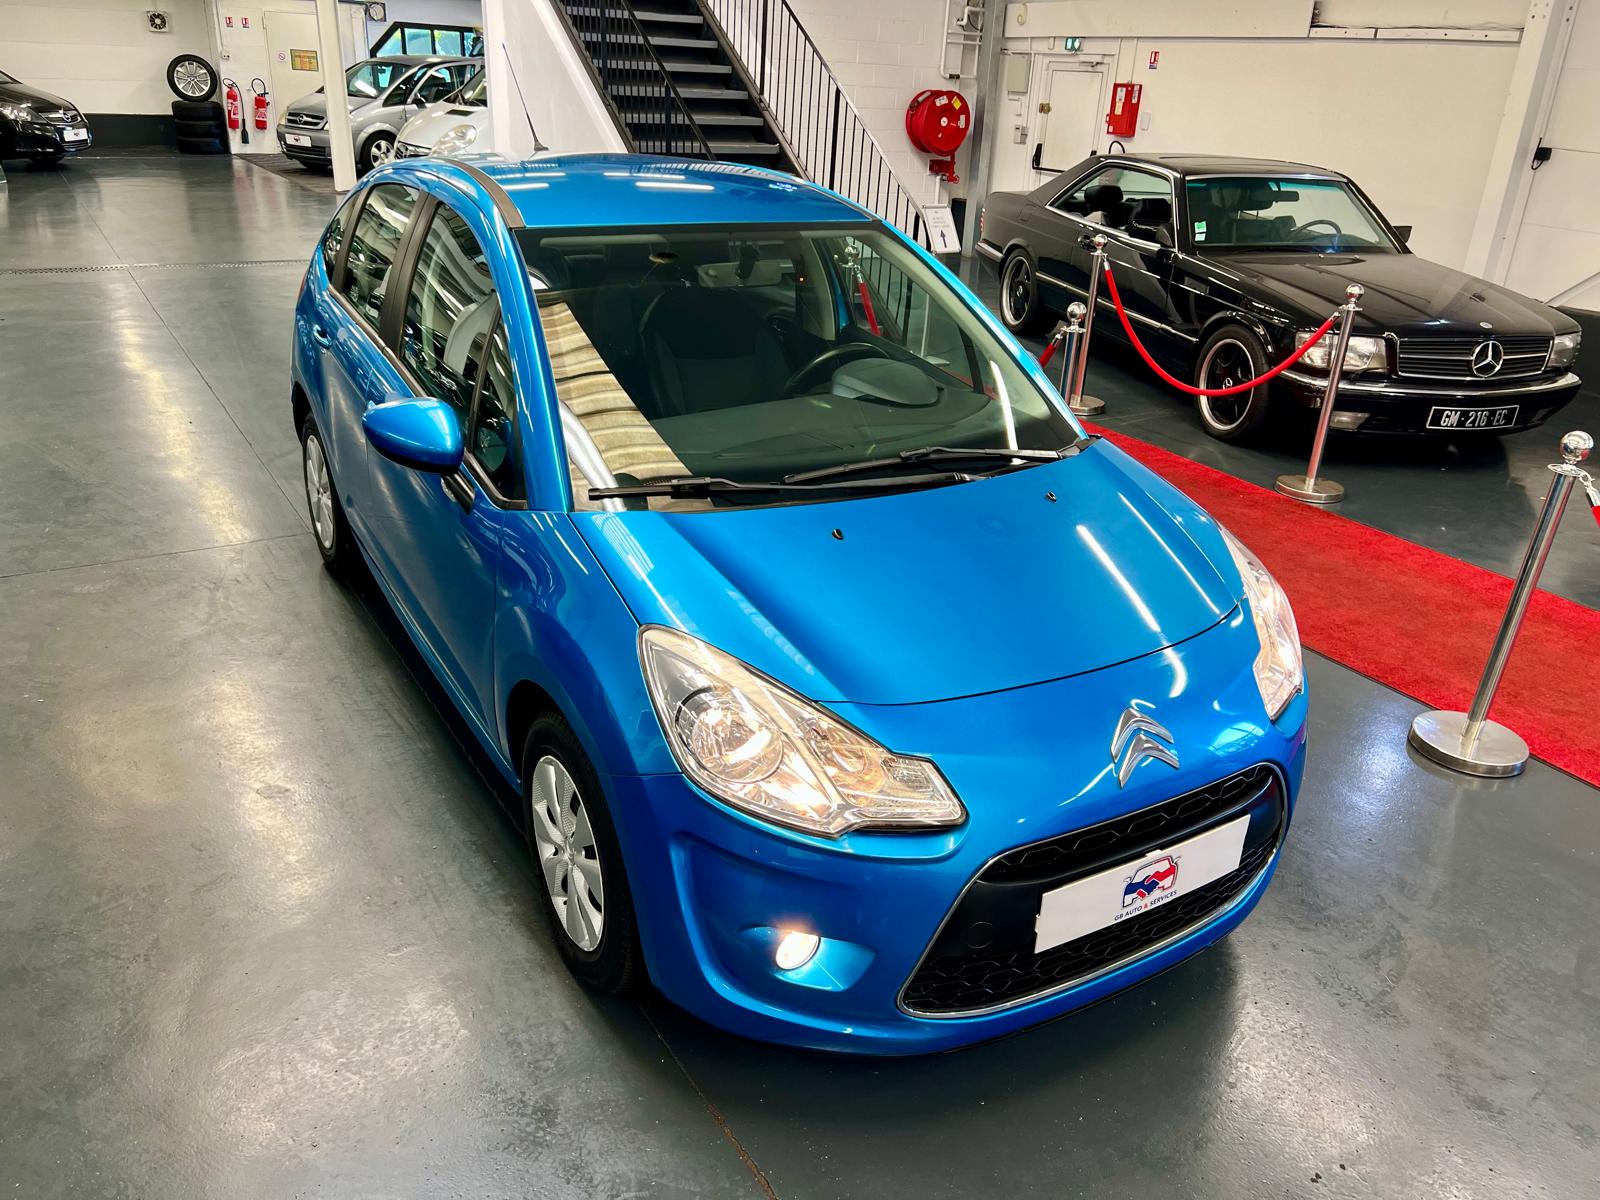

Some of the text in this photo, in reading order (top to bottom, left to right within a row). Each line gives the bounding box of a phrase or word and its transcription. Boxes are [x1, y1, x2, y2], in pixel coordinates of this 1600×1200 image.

[1114, 913, 1124, 921] GB
[1125, 906, 1142, 916] AUTO
[1150, 890, 1177, 906] SERVICES
